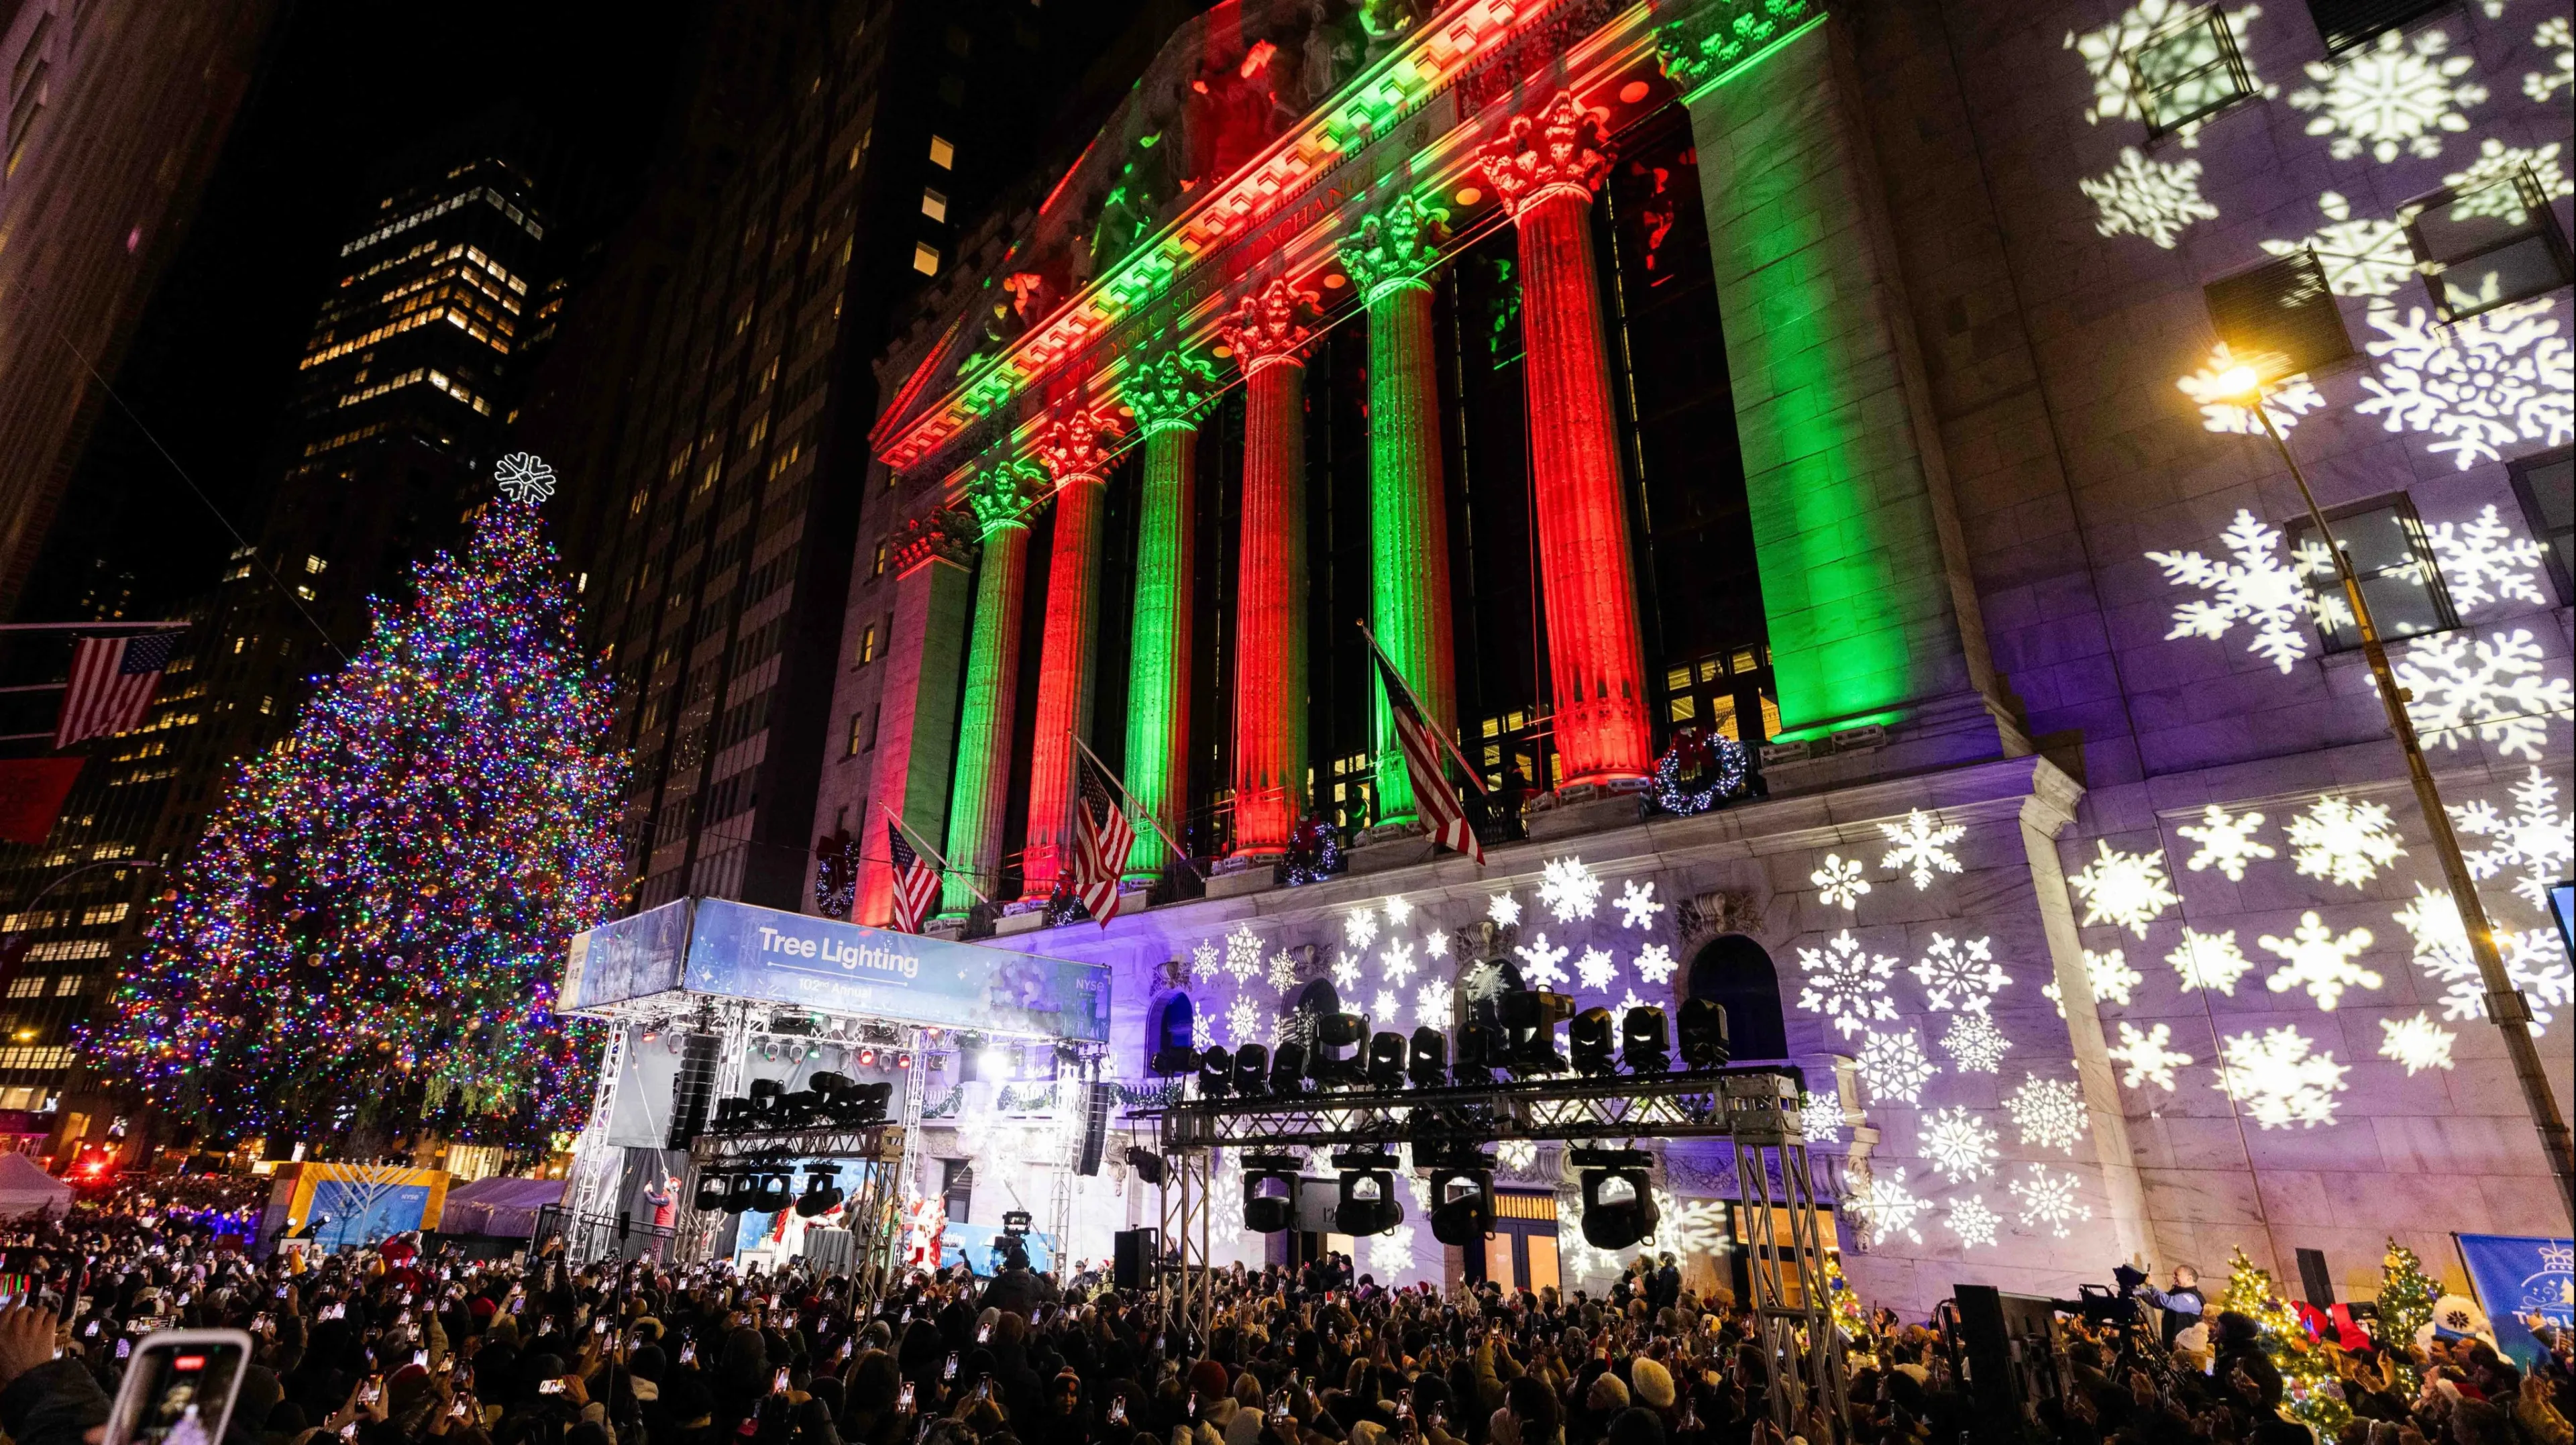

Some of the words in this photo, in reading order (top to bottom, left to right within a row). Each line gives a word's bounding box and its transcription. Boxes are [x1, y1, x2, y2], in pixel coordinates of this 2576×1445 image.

[1110, 310, 1159, 357] YORK
[1171, 256, 1235, 315] STOC
[759, 926, 816, 958] Tree
[821, 938, 918, 977] Lighting
